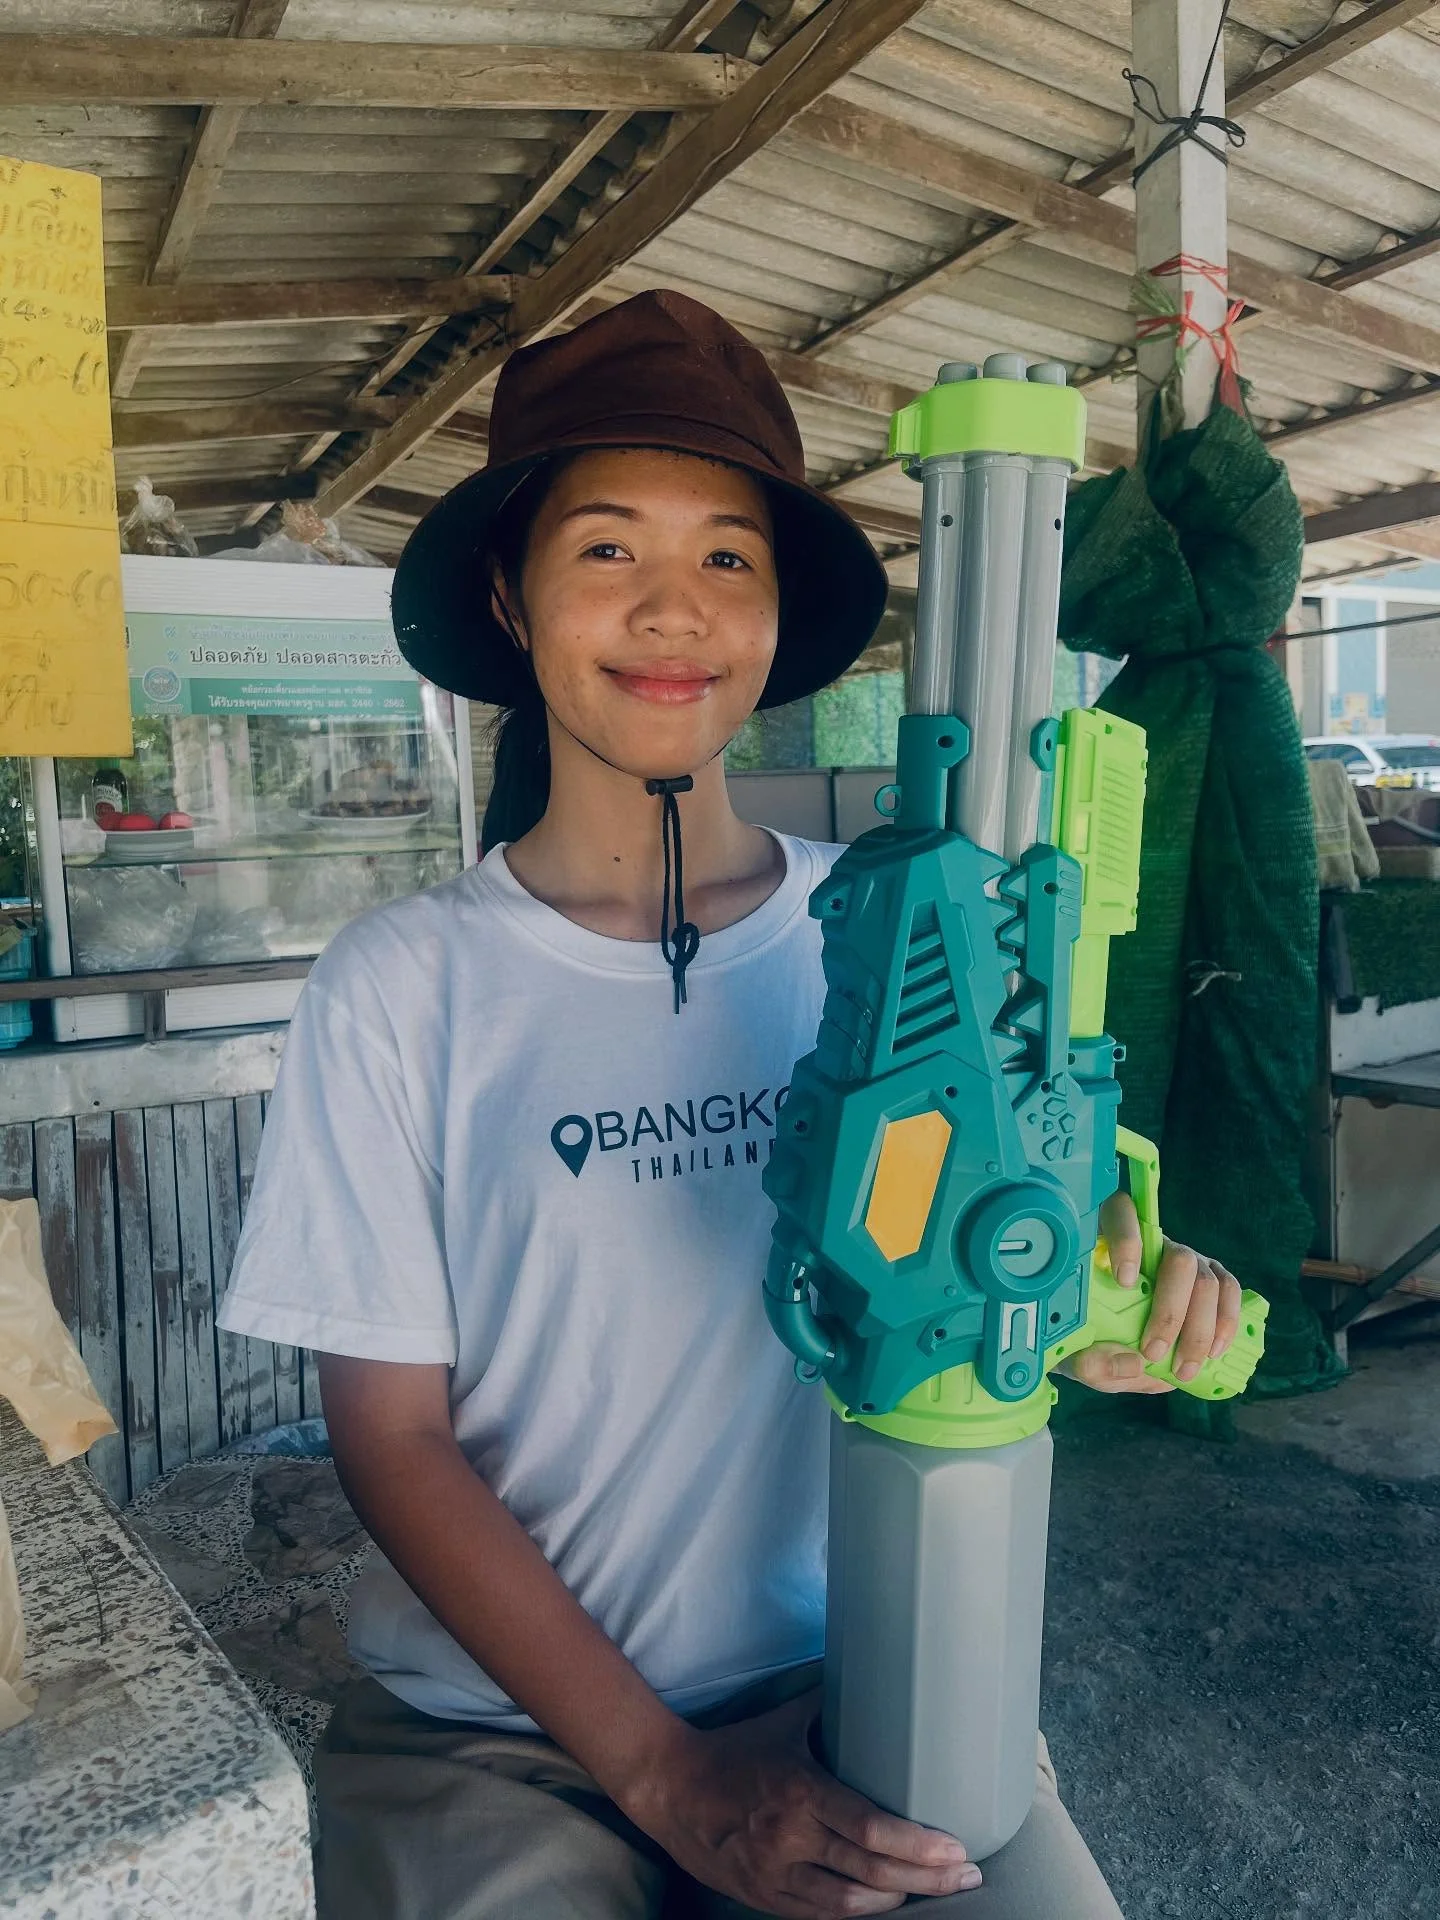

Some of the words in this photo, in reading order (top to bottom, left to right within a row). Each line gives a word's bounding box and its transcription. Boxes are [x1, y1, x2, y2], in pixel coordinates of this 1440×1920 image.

[190, 645, 268, 664] ปลอดภัย
[276, 646, 402, 667] ปลอดสารตะกั่ว
